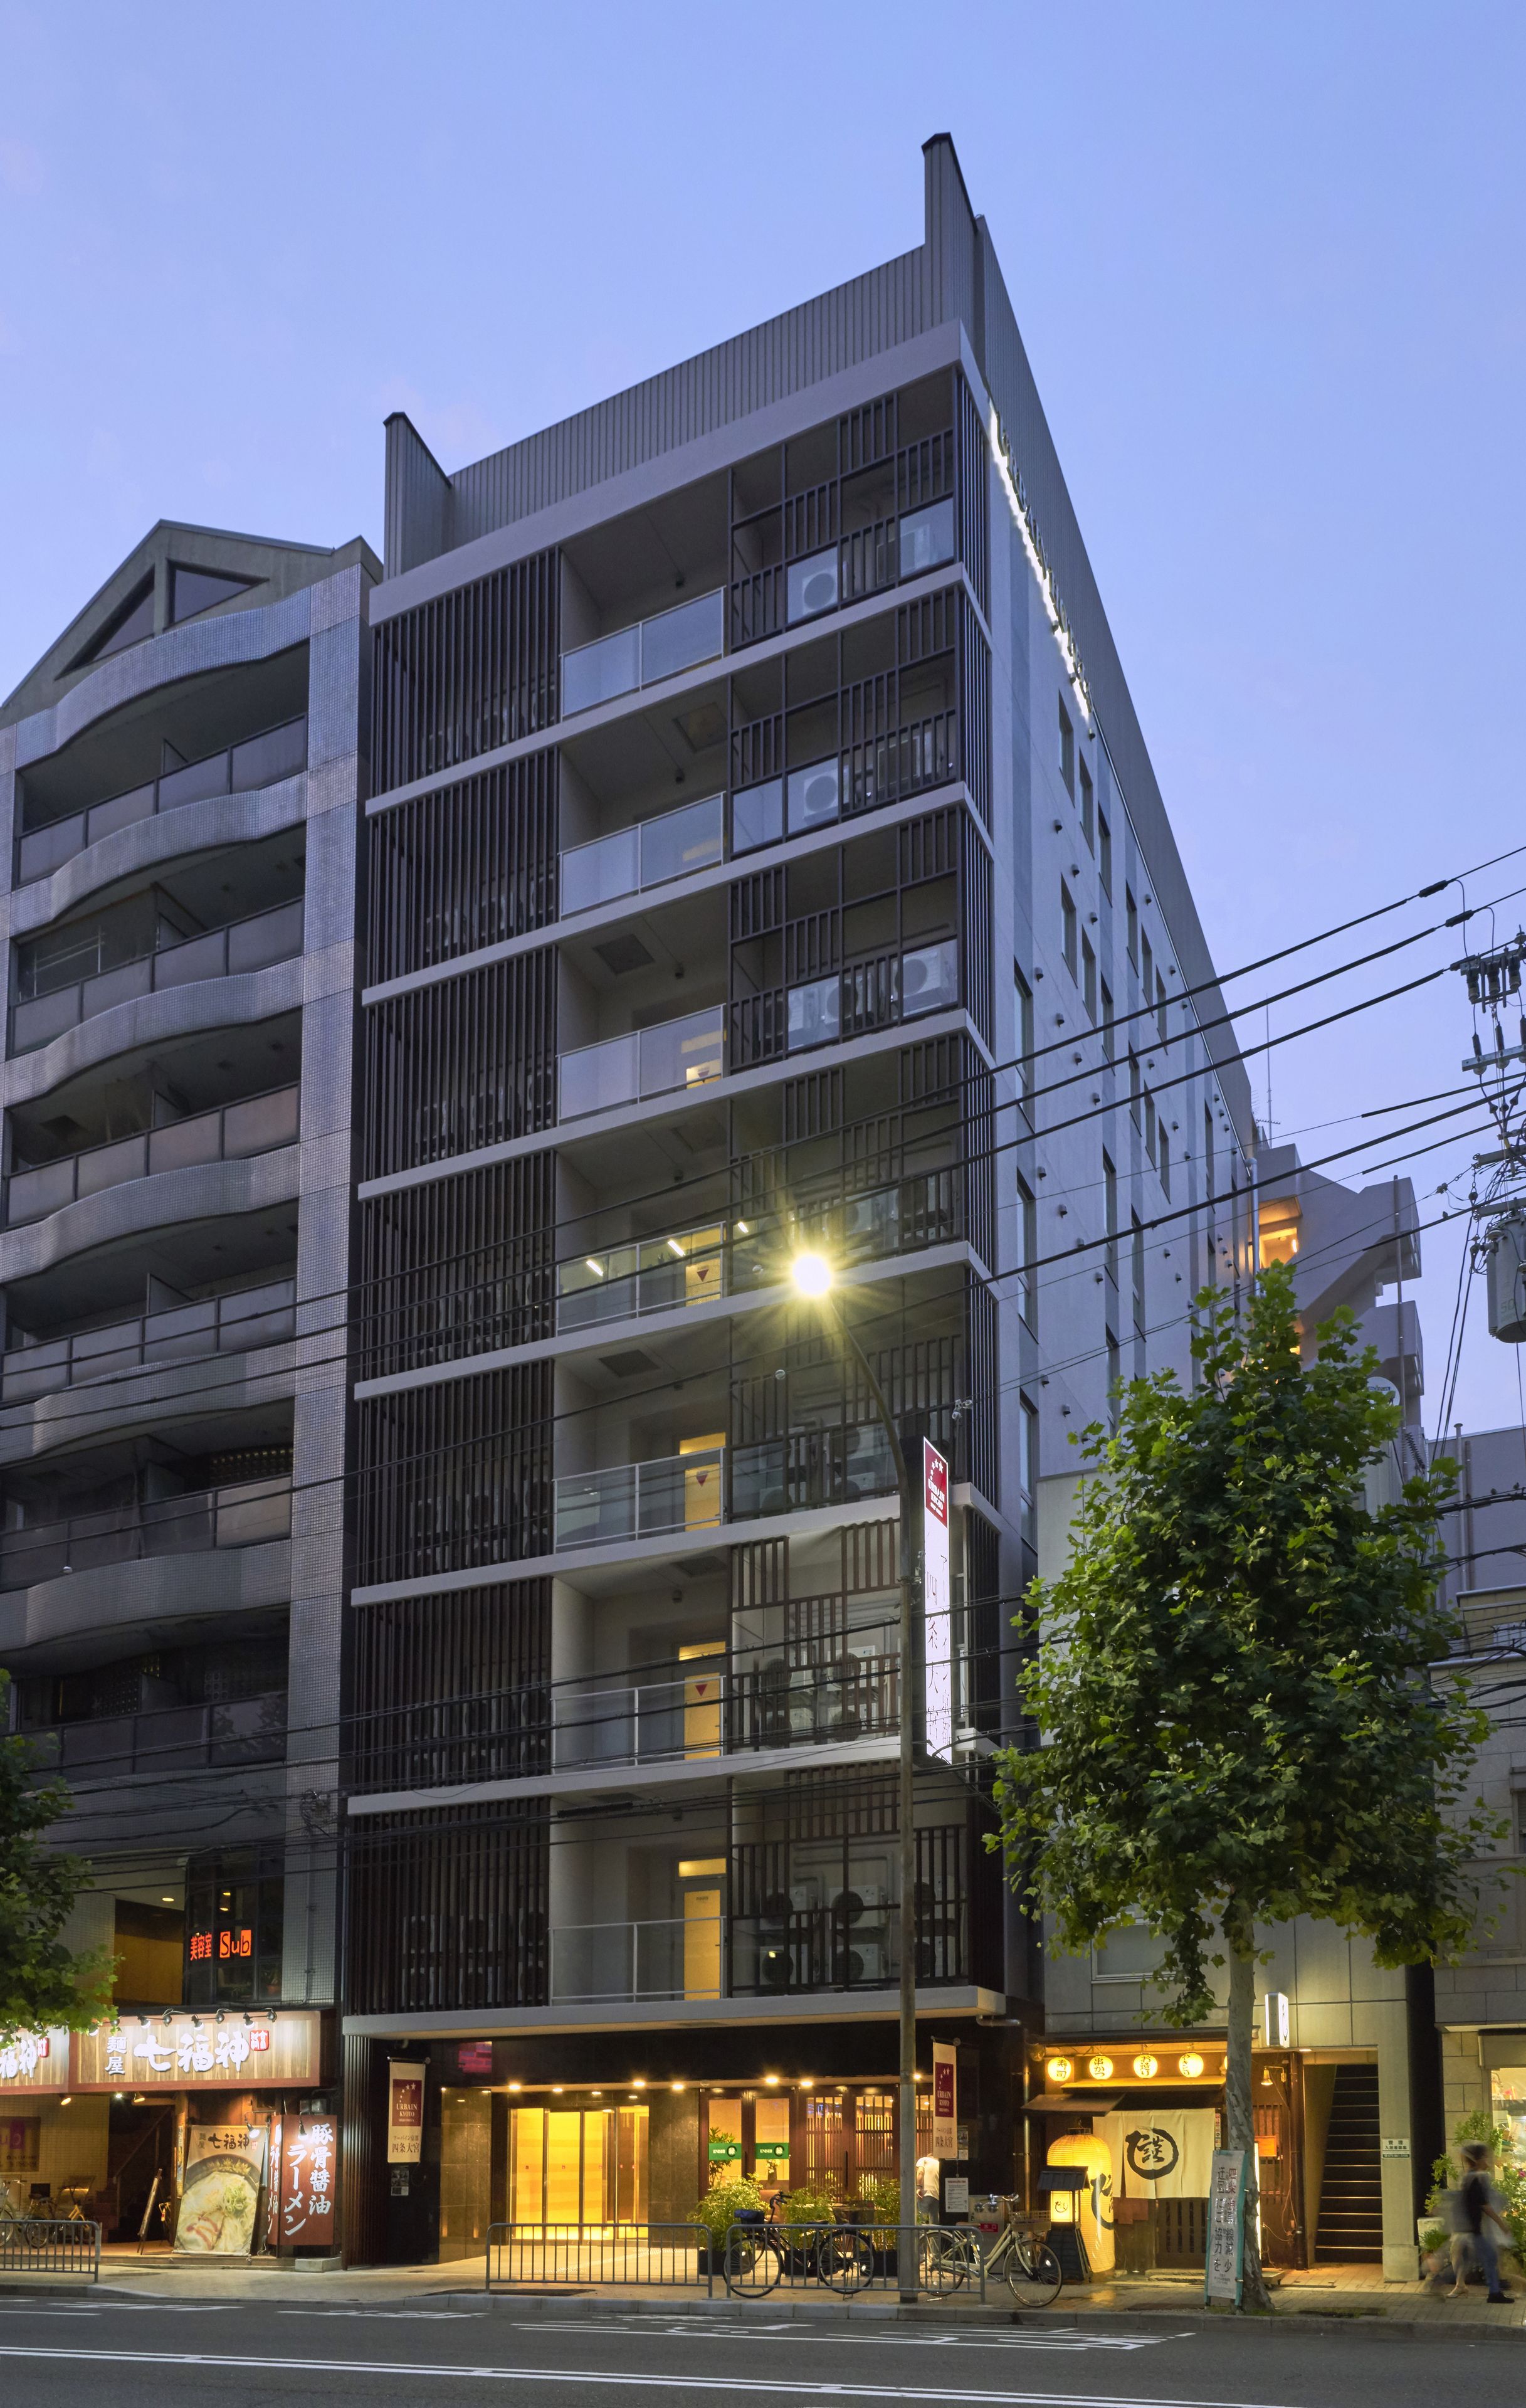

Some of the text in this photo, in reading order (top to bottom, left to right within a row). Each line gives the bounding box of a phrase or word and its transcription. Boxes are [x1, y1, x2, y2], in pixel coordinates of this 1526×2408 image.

[190, 1930, 251, 1962] 美容室 Sub
[105, 2036, 127, 2076] 麺屋
[133, 2030, 250, 2073] 七福神
[1056, 2059, 1068, 2079] 寿司
[1093, 2057, 1105, 2078] 串かつ
[396, 2103, 418, 2111] URBAIN
[208, 2133, 250, 2151] 七福神
[392, 2142, 420, 2153] 四条大宮
[309, 2123, 334, 2215] 豚骨醤油
[283, 2143, 308, 2236] ラーメン
